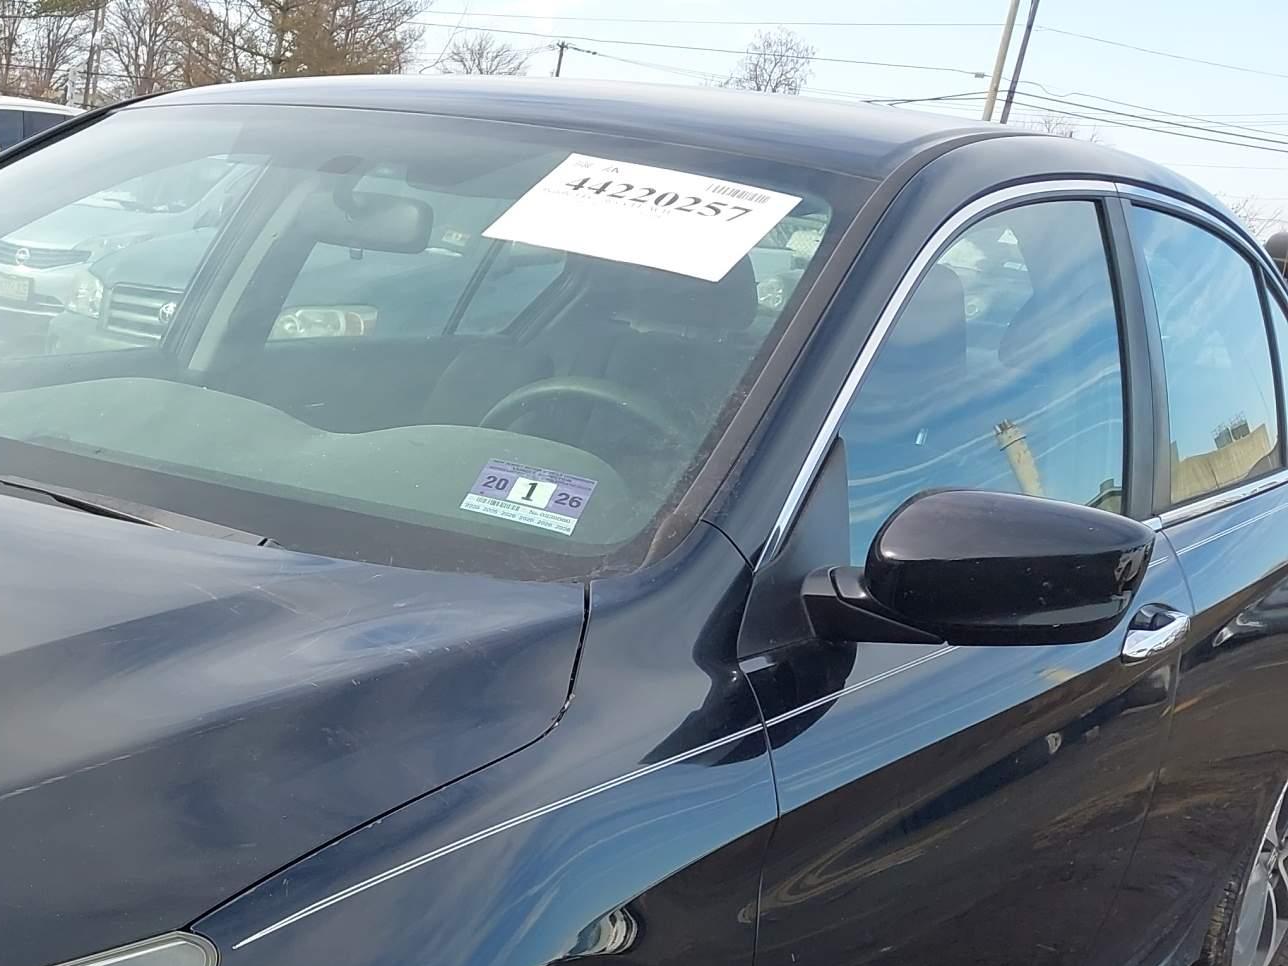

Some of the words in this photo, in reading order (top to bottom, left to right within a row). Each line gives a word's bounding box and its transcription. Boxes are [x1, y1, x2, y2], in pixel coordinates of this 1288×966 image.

[565, 177, 753, 222] 44220257
[482, 475, 509, 491] 20
[521, 482, 539, 502] 1
[554, 492, 583, 509] 26
